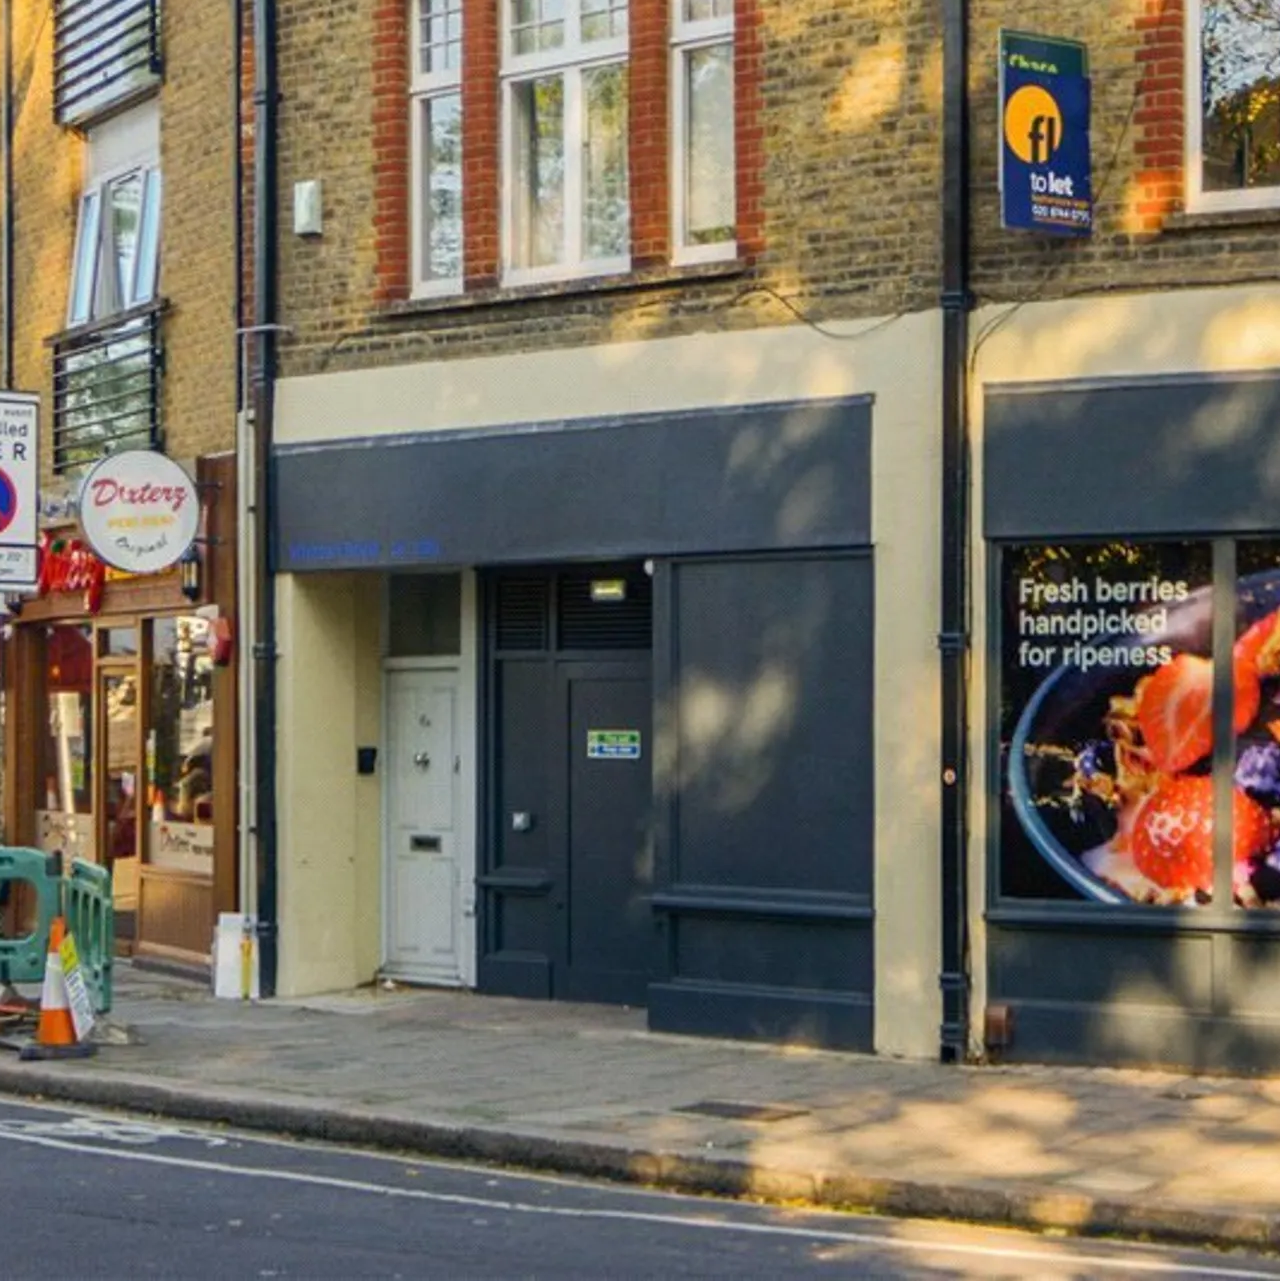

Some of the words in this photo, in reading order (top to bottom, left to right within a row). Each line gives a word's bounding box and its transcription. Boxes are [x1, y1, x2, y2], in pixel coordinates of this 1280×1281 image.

[1030, 172, 1047, 193] to
[1048, 171, 1074, 197] let
[12, 442, 27, 461] R
[91, 477, 188, 512] Dixterz
[1019, 577, 1088, 603] Fresh
[1096, 576, 1188, 602] berries
[1019, 608, 1167, 639] handpicked
[1019, 641, 1057, 666] for
[1062, 642, 1172, 672] ripeness
